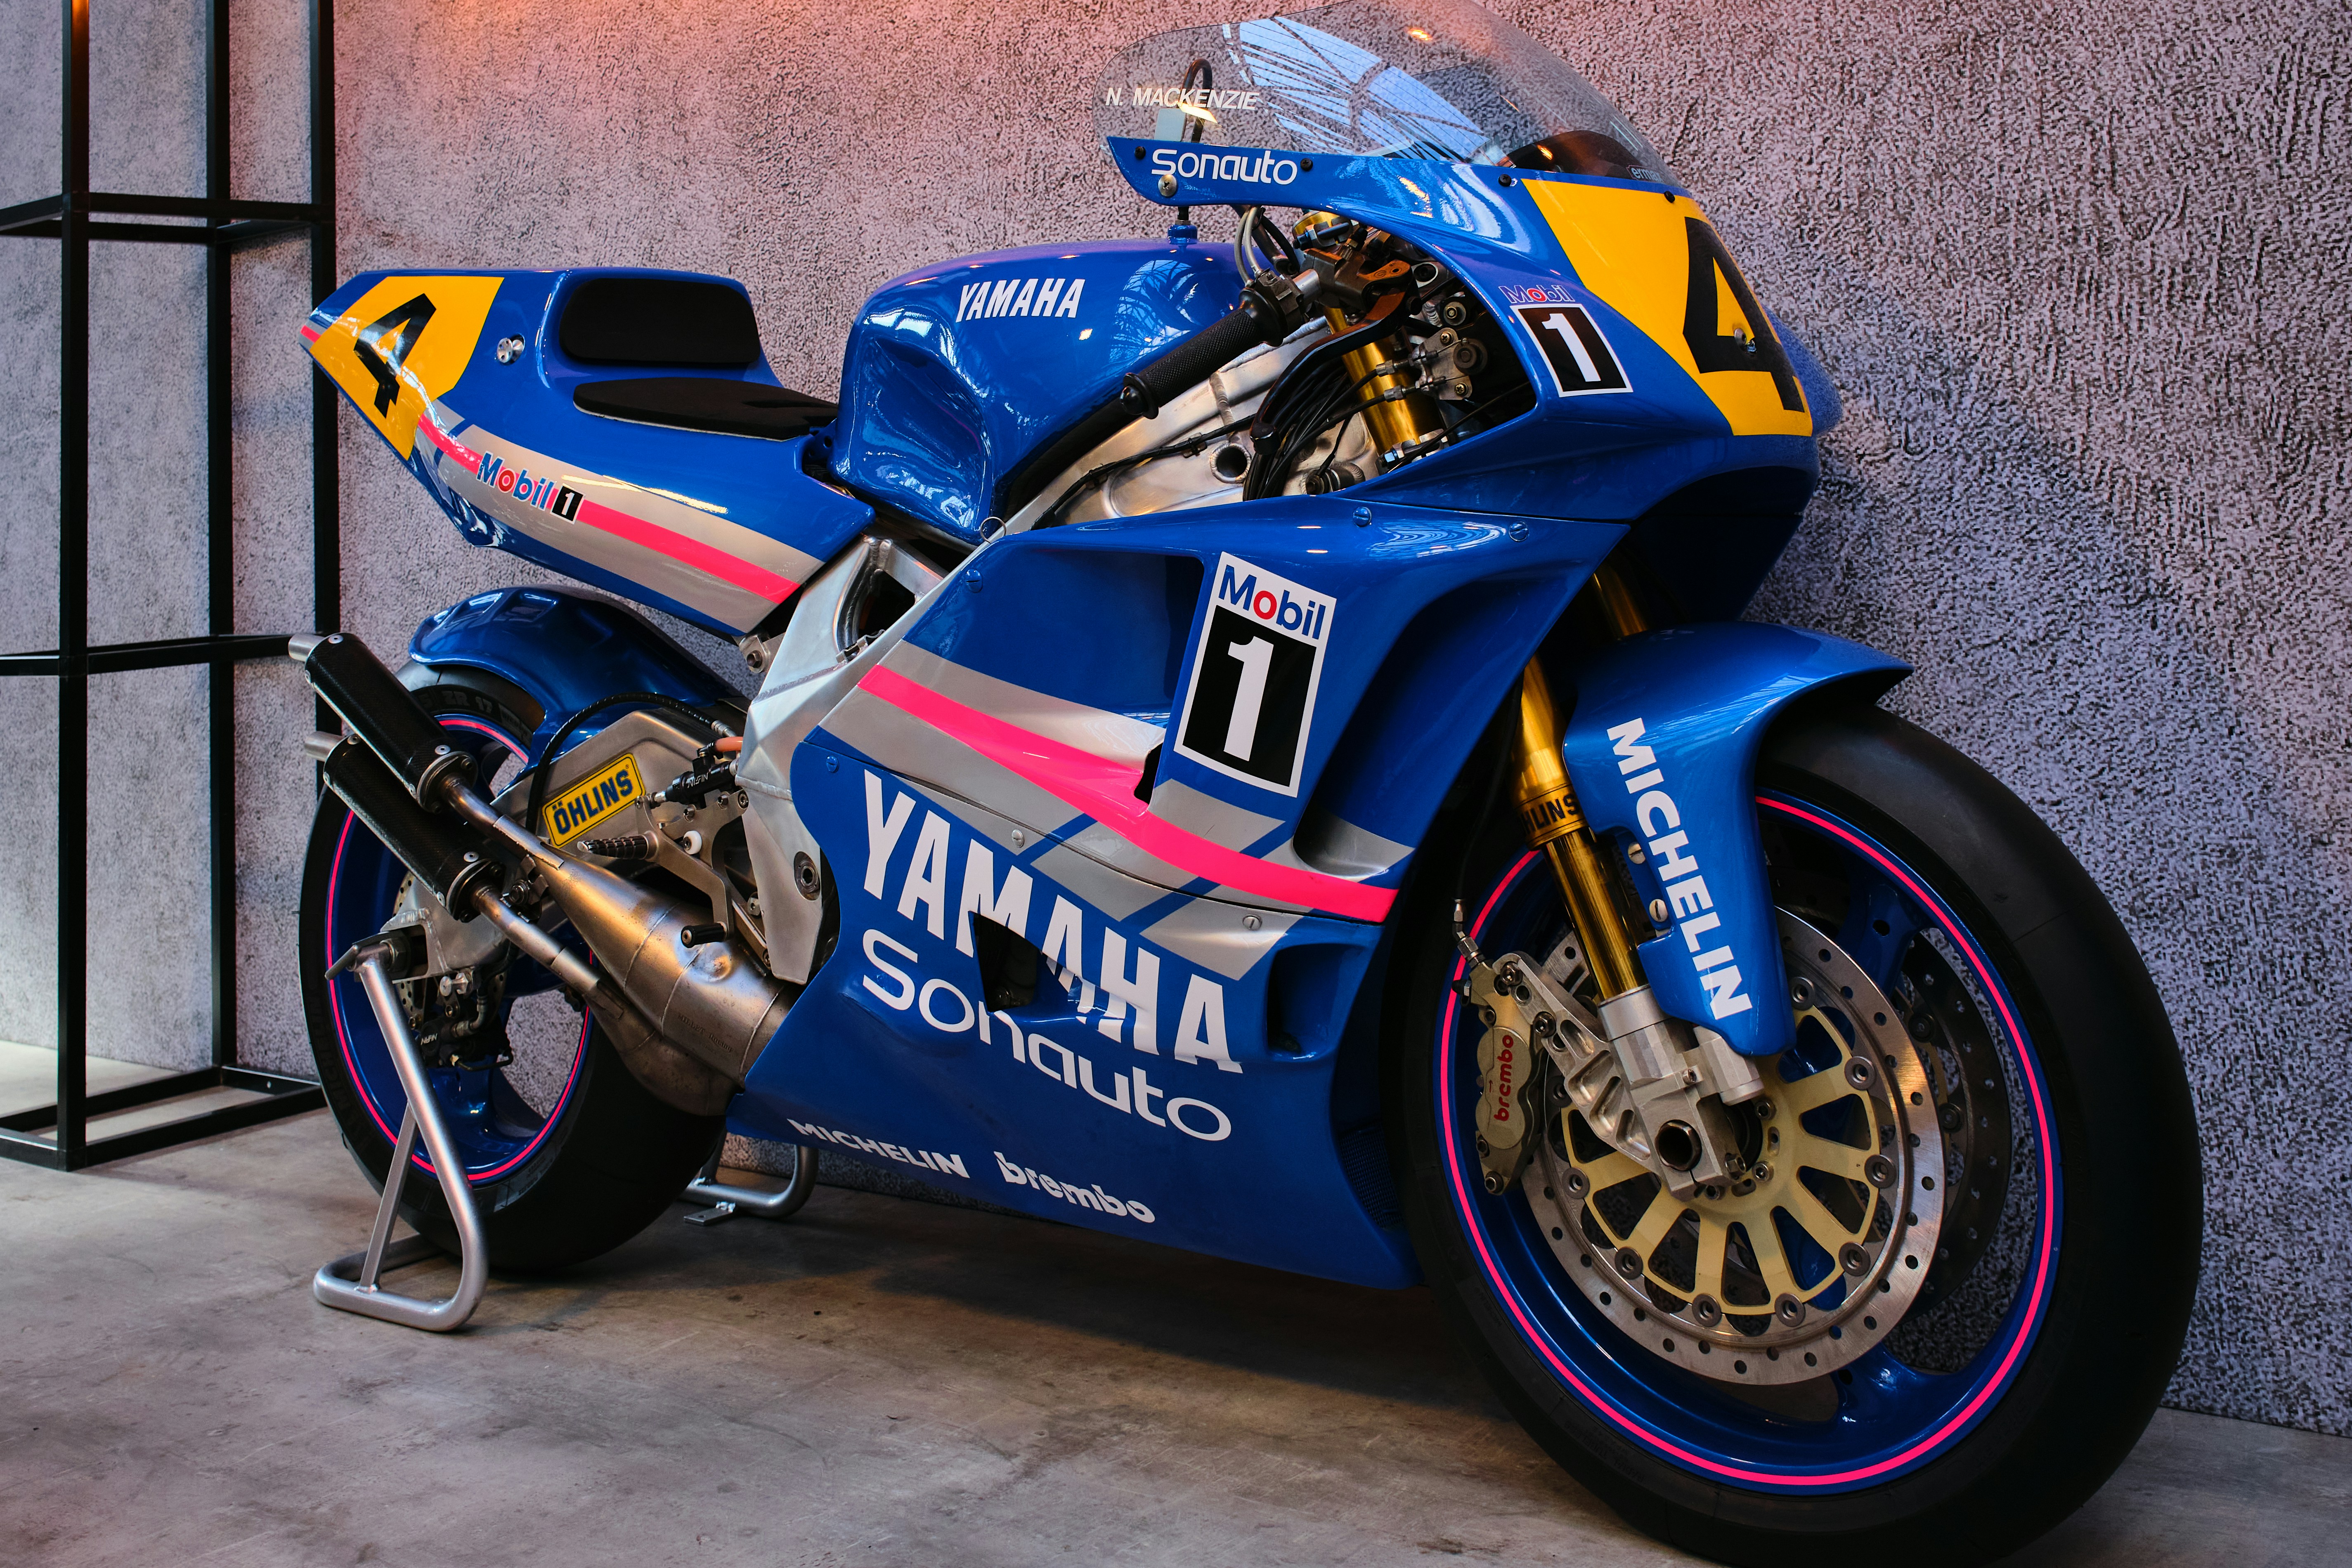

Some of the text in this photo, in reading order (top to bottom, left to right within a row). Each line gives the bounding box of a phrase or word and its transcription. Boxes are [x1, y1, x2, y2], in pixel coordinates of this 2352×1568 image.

[1106, 87, 1260, 110] N. MACKENZIE
[955, 279, 1085, 323] YAMAHA
[1499, 285, 1575, 303] Mobil
[1683, 217, 1806, 413] 4
[354, 293, 436, 418] 4
[1541, 313, 1601, 382] 1
[476, 451, 575, 516] Mobil 1
[1218, 564, 1326, 640] Mobil
[1224, 636, 1274, 761] 1
[552, 769, 634, 836] ÖHLINS
[1518, 793, 1580, 834] HLINS
[1606, 717, 1753, 1020] MICHELIN
[864, 769, 1243, 1074] YAMAHA
[863, 929, 1232, 1141] Sonauto
[787, 1118, 970, 1179] MICHELIN
[994, 1151, 1156, 1223] brembo
